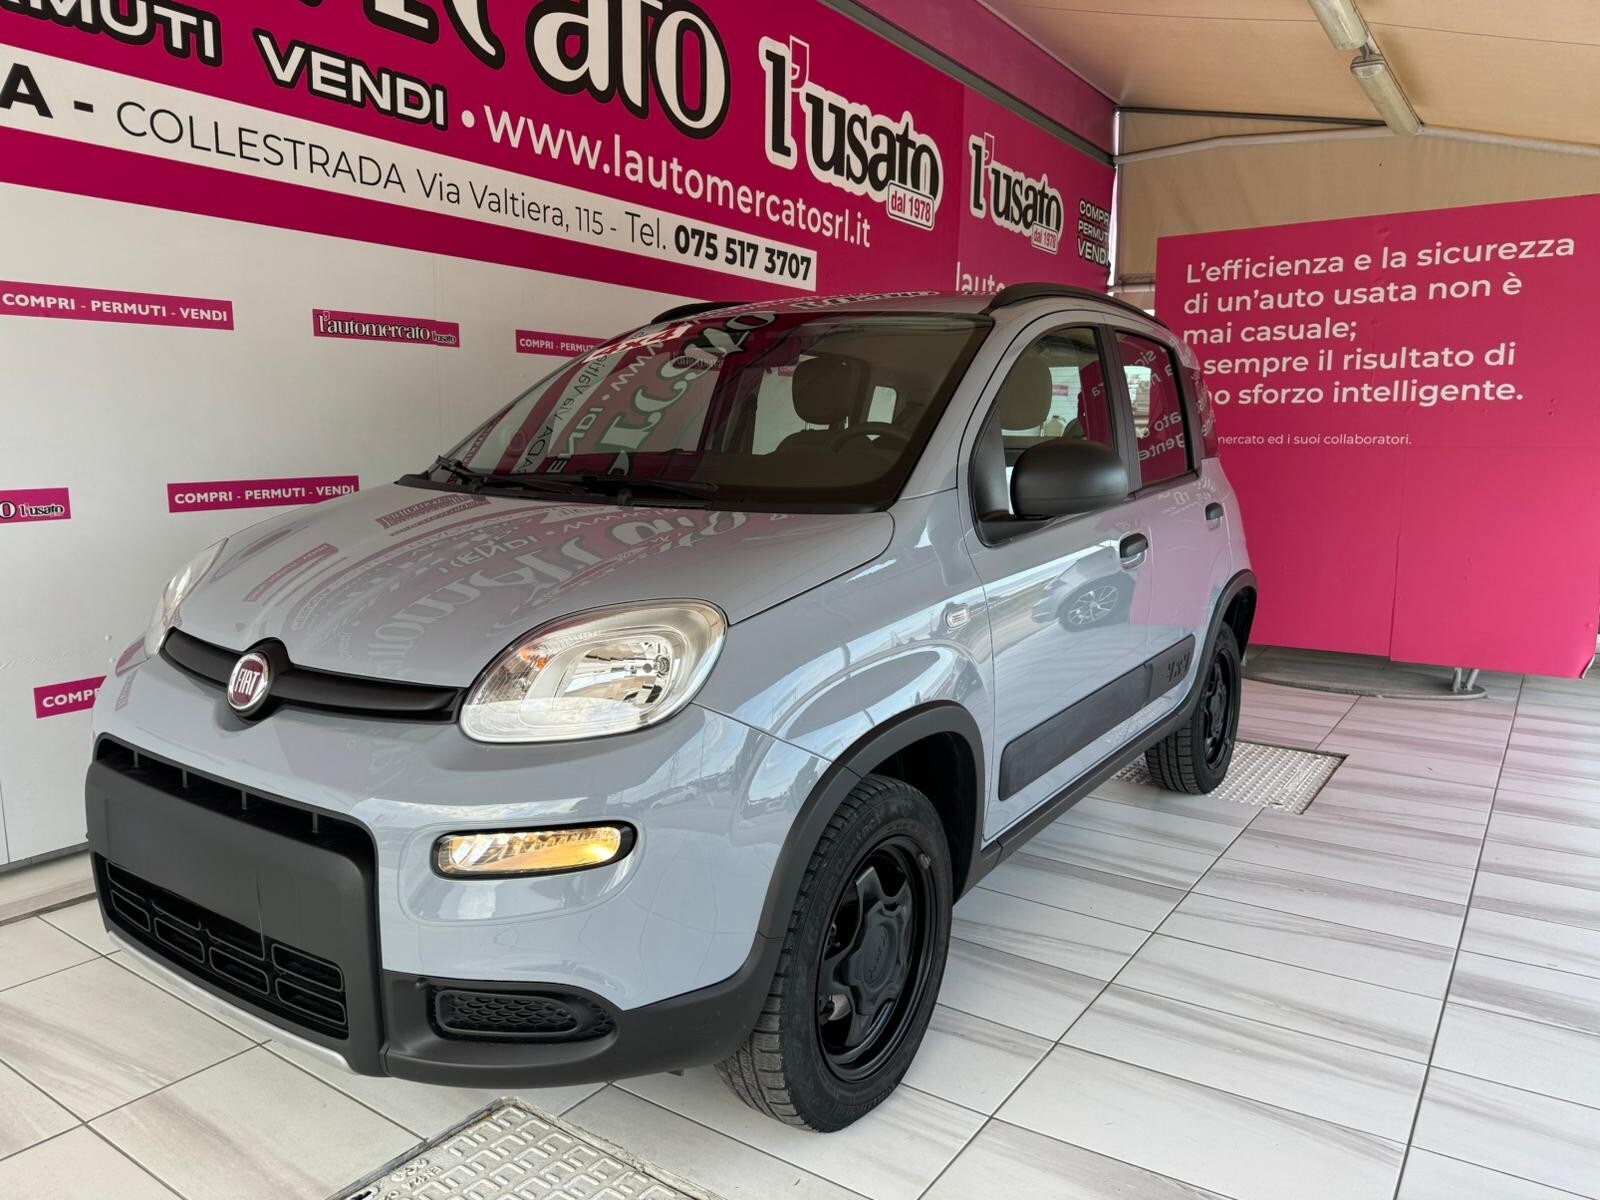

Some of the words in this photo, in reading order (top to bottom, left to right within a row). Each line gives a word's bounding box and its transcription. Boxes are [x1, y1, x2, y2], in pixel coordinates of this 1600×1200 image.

[256, 32, 447, 128] VENDI
[760, 36, 942, 203] l'usato
[117, 101, 407, 194] COLLESTRADA
[416, 169, 461, 205] Via
[469, 180, 569, 232] Valtiera,
[576, 207, 603, 236] 115
[625, 211, 667, 250] Tel.
[674, 224, 718, 261] 075
[724, 237, 759, 270] 517
[764, 246, 812, 281] 3707
[484, 104, 871, 248] www.lautomercatosrl.it
[970, 133, 1063, 236] l'usato
[890, 188, 907, 213] dal
[907, 192, 931, 220] 1978
[1033, 229, 1042, 244] dal
[1186, 253, 1344, 285] L'efficienza
[1354, 252, 1371, 270] e
[1382, 247, 1406, 269] la
[1417, 237, 1576, 266] sicurezza
[2, 293, 76, 310] COMPRI
[91, 300, 167, 317] PERMUTI
[180, 307, 228, 322] VENDI
[1184, 293, 1208, 314] di
[1217, 288, 1324, 312] un'auto
[1334, 280, 1417, 305] usata
[1428, 278, 1491, 300] non
[1502, 271, 1522, 295] è
[319, 310, 431, 340] l'automercato
[1183, 322, 1232, 344] mai
[1241, 317, 1357, 343] casuale;
[519, 338, 554, 350] COMPRI
[1203, 353, 1309, 378] sempre
[1318, 349, 1332, 371] il
[1343, 345, 1474, 371] risultato
[1484, 341, 1516, 366] di
[1238, 383, 1323, 405] sforzo
[1333, 378, 1523, 408] intelligente.
[1268, 433, 1284, 445] ed
[1287, 434, 1291, 444] i
[1293, 433, 1320, 445] suoi
[1323, 433, 1412, 445] collaboratori.
[174, 491, 233, 504] COMPRI
[245, 487, 306, 500] PERMUTI
[316, 485, 355, 496] VENDI
[234, 668, 260, 696] FIAT
